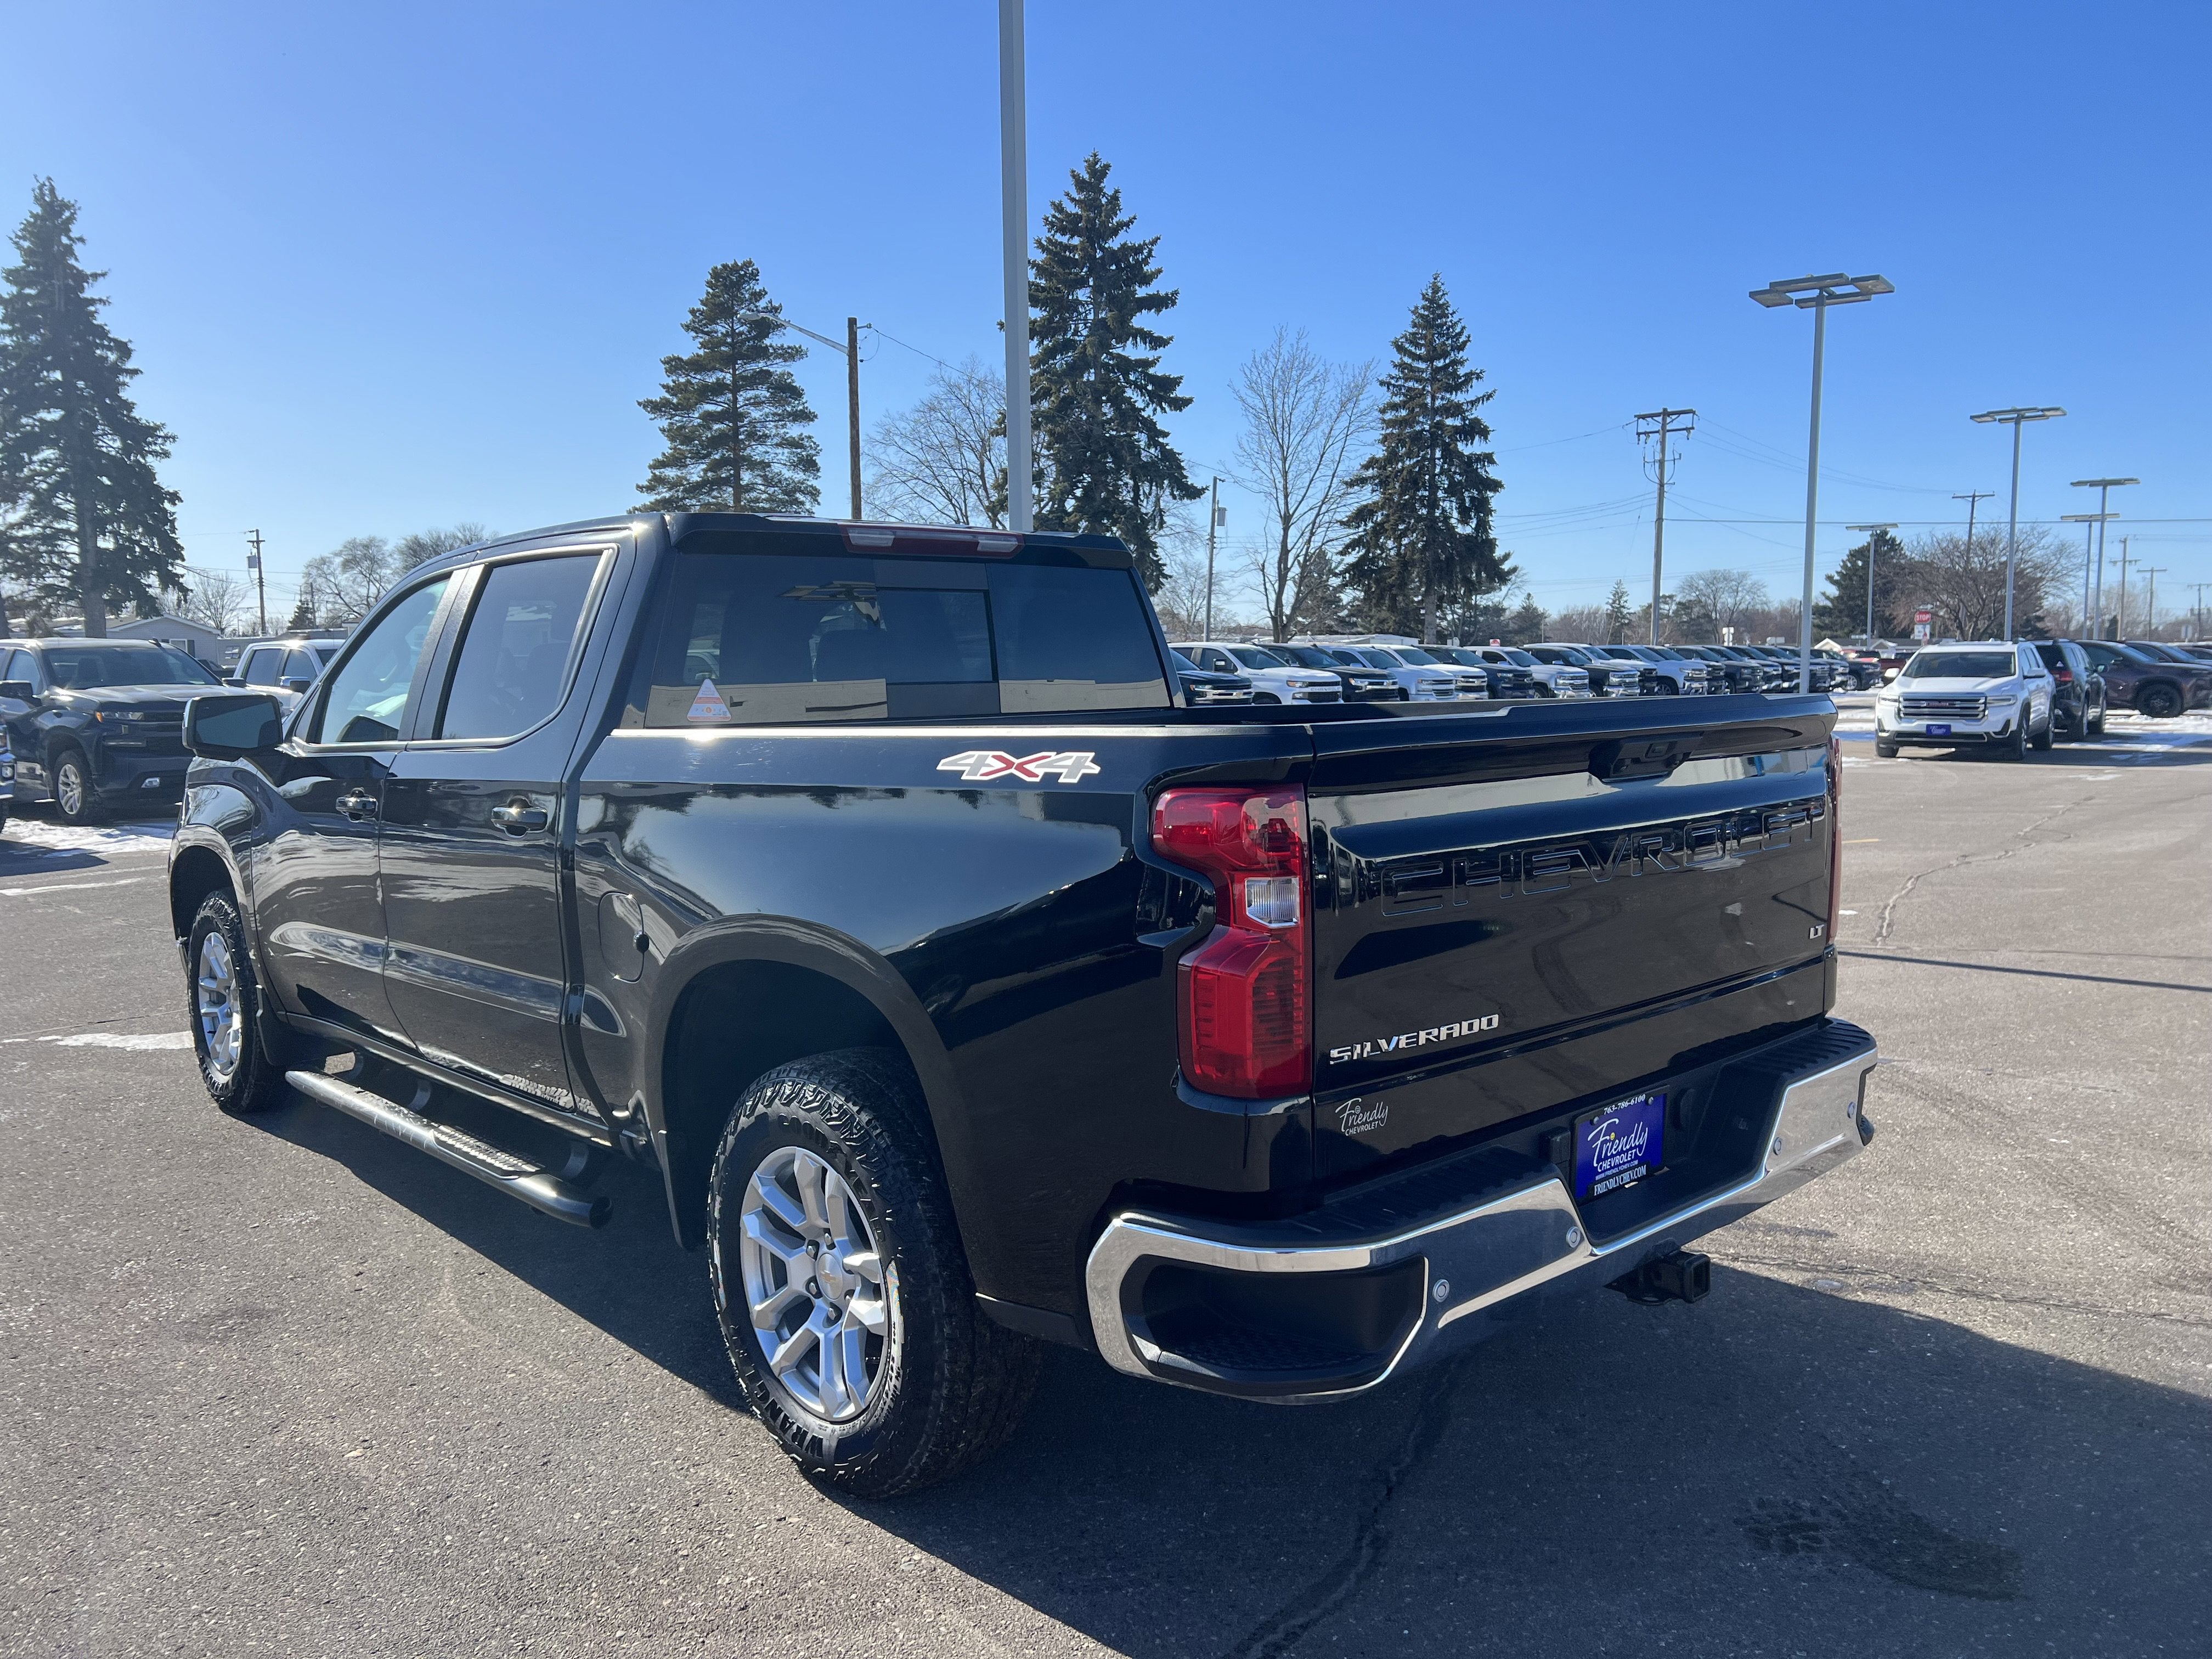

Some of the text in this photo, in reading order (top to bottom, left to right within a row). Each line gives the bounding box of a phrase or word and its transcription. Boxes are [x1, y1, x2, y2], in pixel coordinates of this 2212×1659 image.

[1381, 801, 1825, 917] CHEVROLET
[1809, 924, 1825, 939] LT
[1329, 1014, 1499, 1065] SILVERADO
[1335, 1097, 1389, 1132] Friendly
[1604, 1093, 1646, 1115] 763-786-6100
[1345, 1121, 1379, 1137] CHEVROLET
[1587, 1118, 1649, 1167] Friendly
[1597, 1149, 1637, 1172] CHEVROLET
[1594, 1164, 1646, 1197] FRIENDLYCHEV.COM
